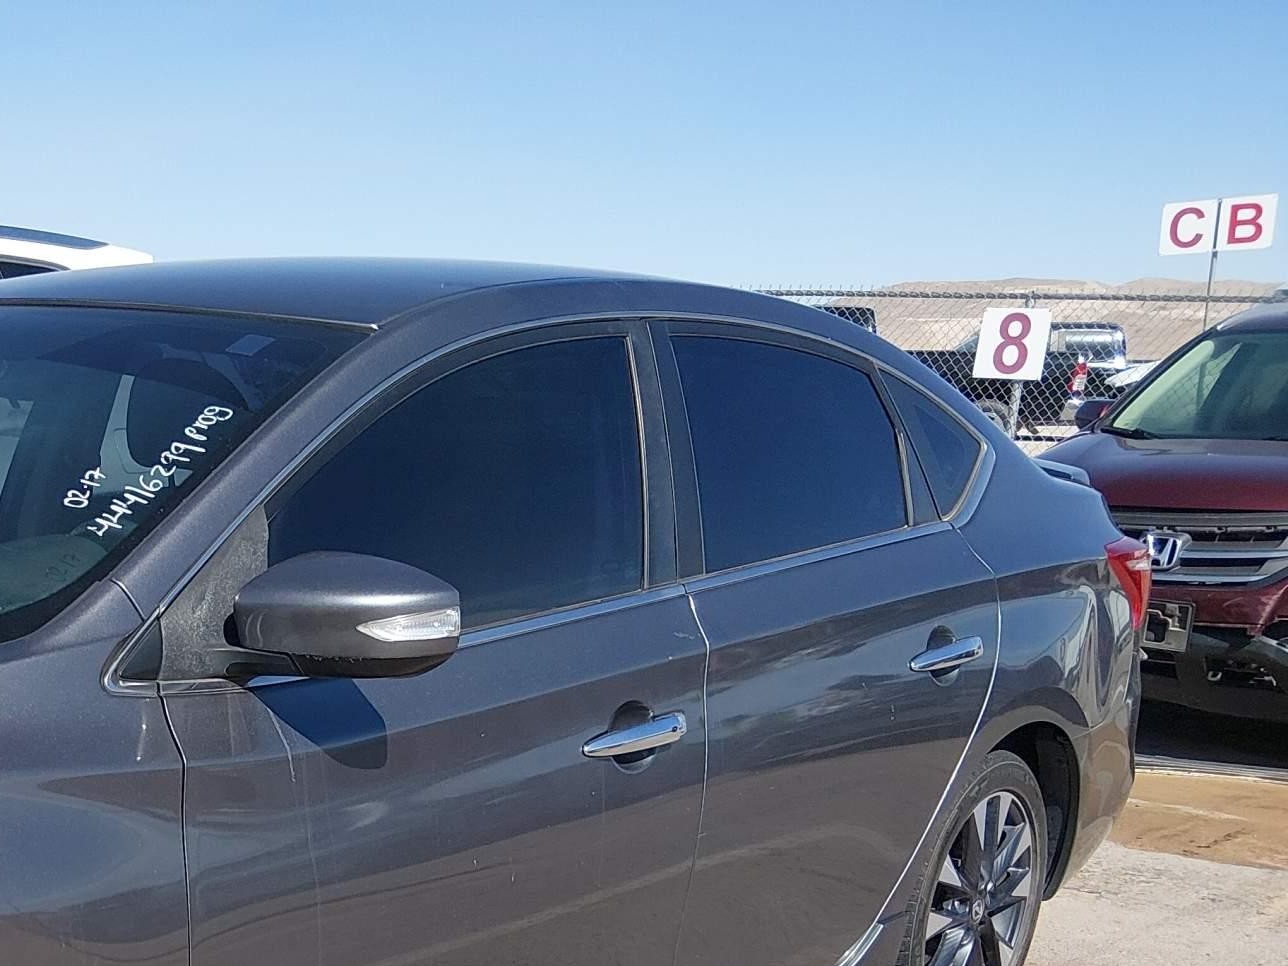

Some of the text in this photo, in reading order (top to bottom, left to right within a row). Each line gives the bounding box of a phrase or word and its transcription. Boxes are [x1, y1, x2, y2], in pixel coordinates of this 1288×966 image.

[1169, 202, 1263, 248] C B
[992, 312, 1032, 375] 8
[87, 442, 206, 536] 44416299
